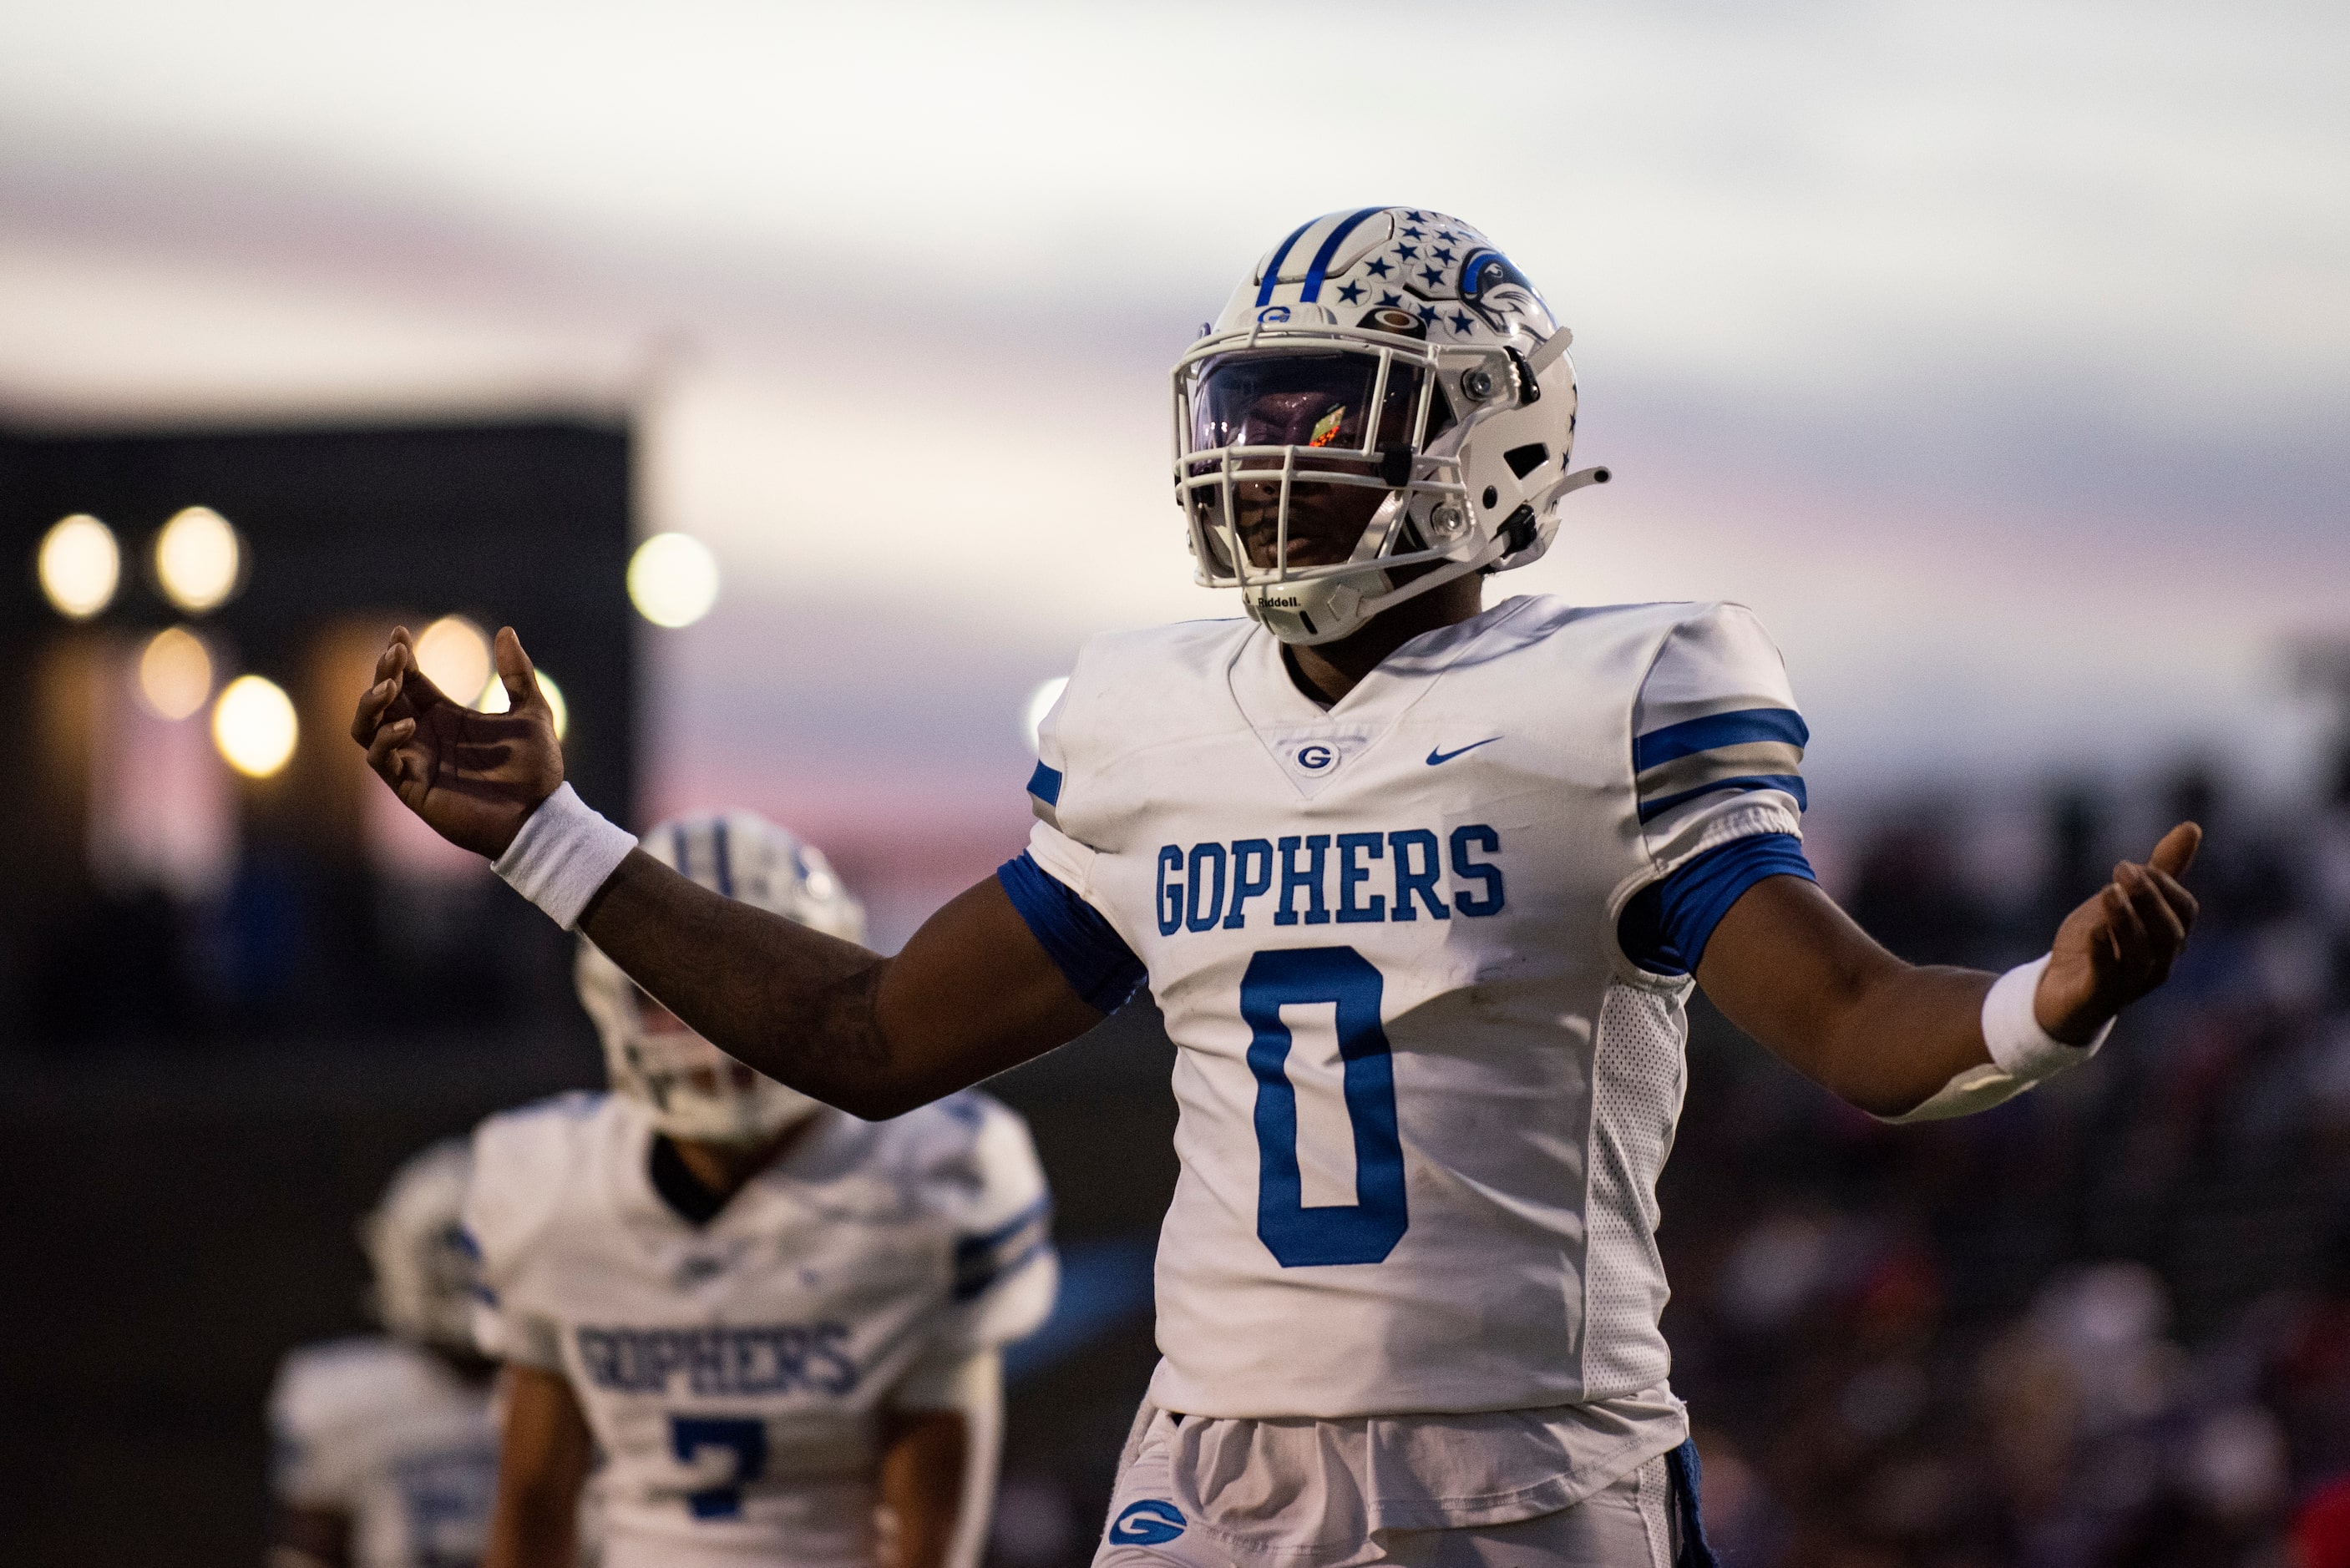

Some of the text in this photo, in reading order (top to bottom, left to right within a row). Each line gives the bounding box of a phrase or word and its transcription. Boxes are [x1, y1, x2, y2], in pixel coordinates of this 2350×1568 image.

[1298, 746, 1331, 769] G
[1156, 824, 1505, 937] GOPHERS
[1240, 945, 1408, 1267] 0
[671, 1414, 767, 1521] 7
[1109, 1499, 1188, 1546] G
